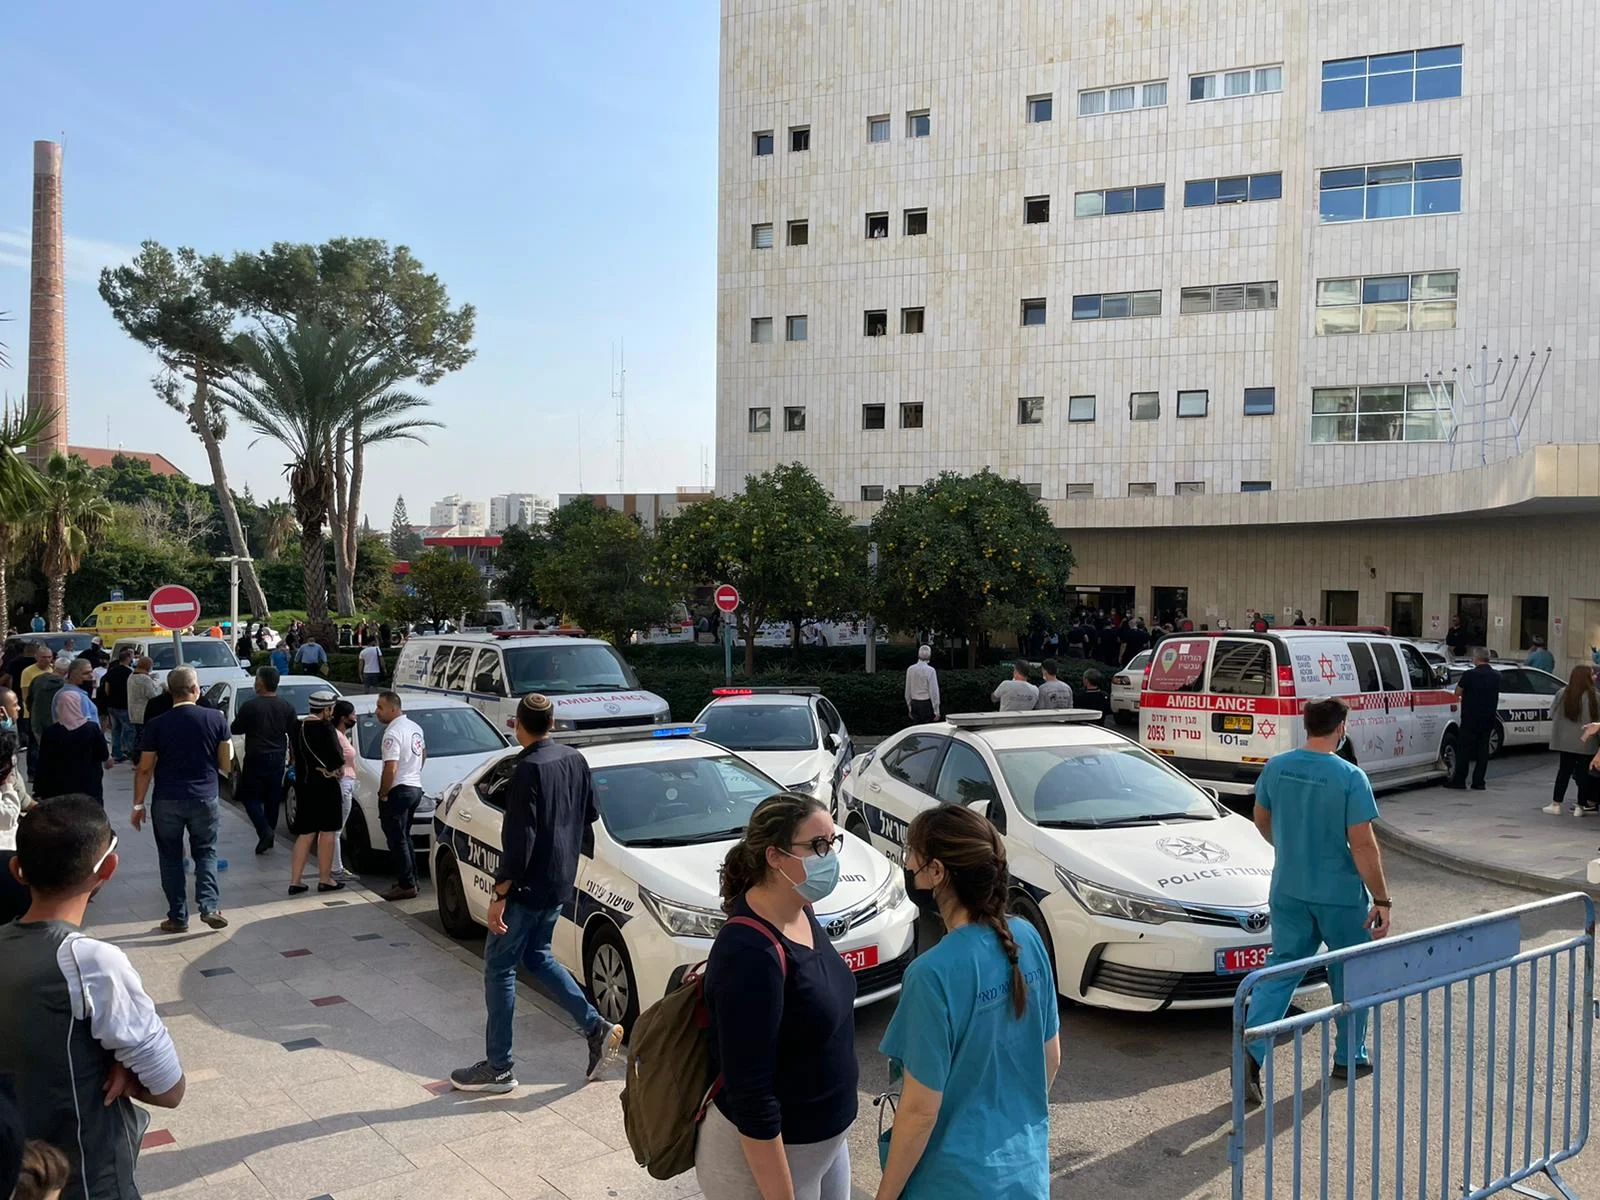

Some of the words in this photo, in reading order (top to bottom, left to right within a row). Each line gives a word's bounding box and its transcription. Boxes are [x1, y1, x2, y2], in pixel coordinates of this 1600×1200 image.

[557, 694, 650, 707] AMBULANCE
[1165, 694, 1256, 712] AMBULANCE
[1151, 713, 1168, 722] אדום
[1169, 714, 1182, 724] דוד
[1185, 715, 1197, 725] מגן
[1509, 708, 1538, 721] ישראל
[1146, 725, 1166, 742] 2053
[1172, 727, 1202, 741] שרון
[1513, 725, 1535, 733] POLICE
[1218, 734, 1238, 746] 101
[880, 810, 909, 844] שראל
[467, 835, 500, 873] ישראל
[1157, 868, 1222, 888] POLICE
[1223, 867, 1273, 876] שטרה
[473, 874, 493, 896] POLI
[586, 879, 607, 899] עירוני
[606, 892, 635, 912] שיטור
